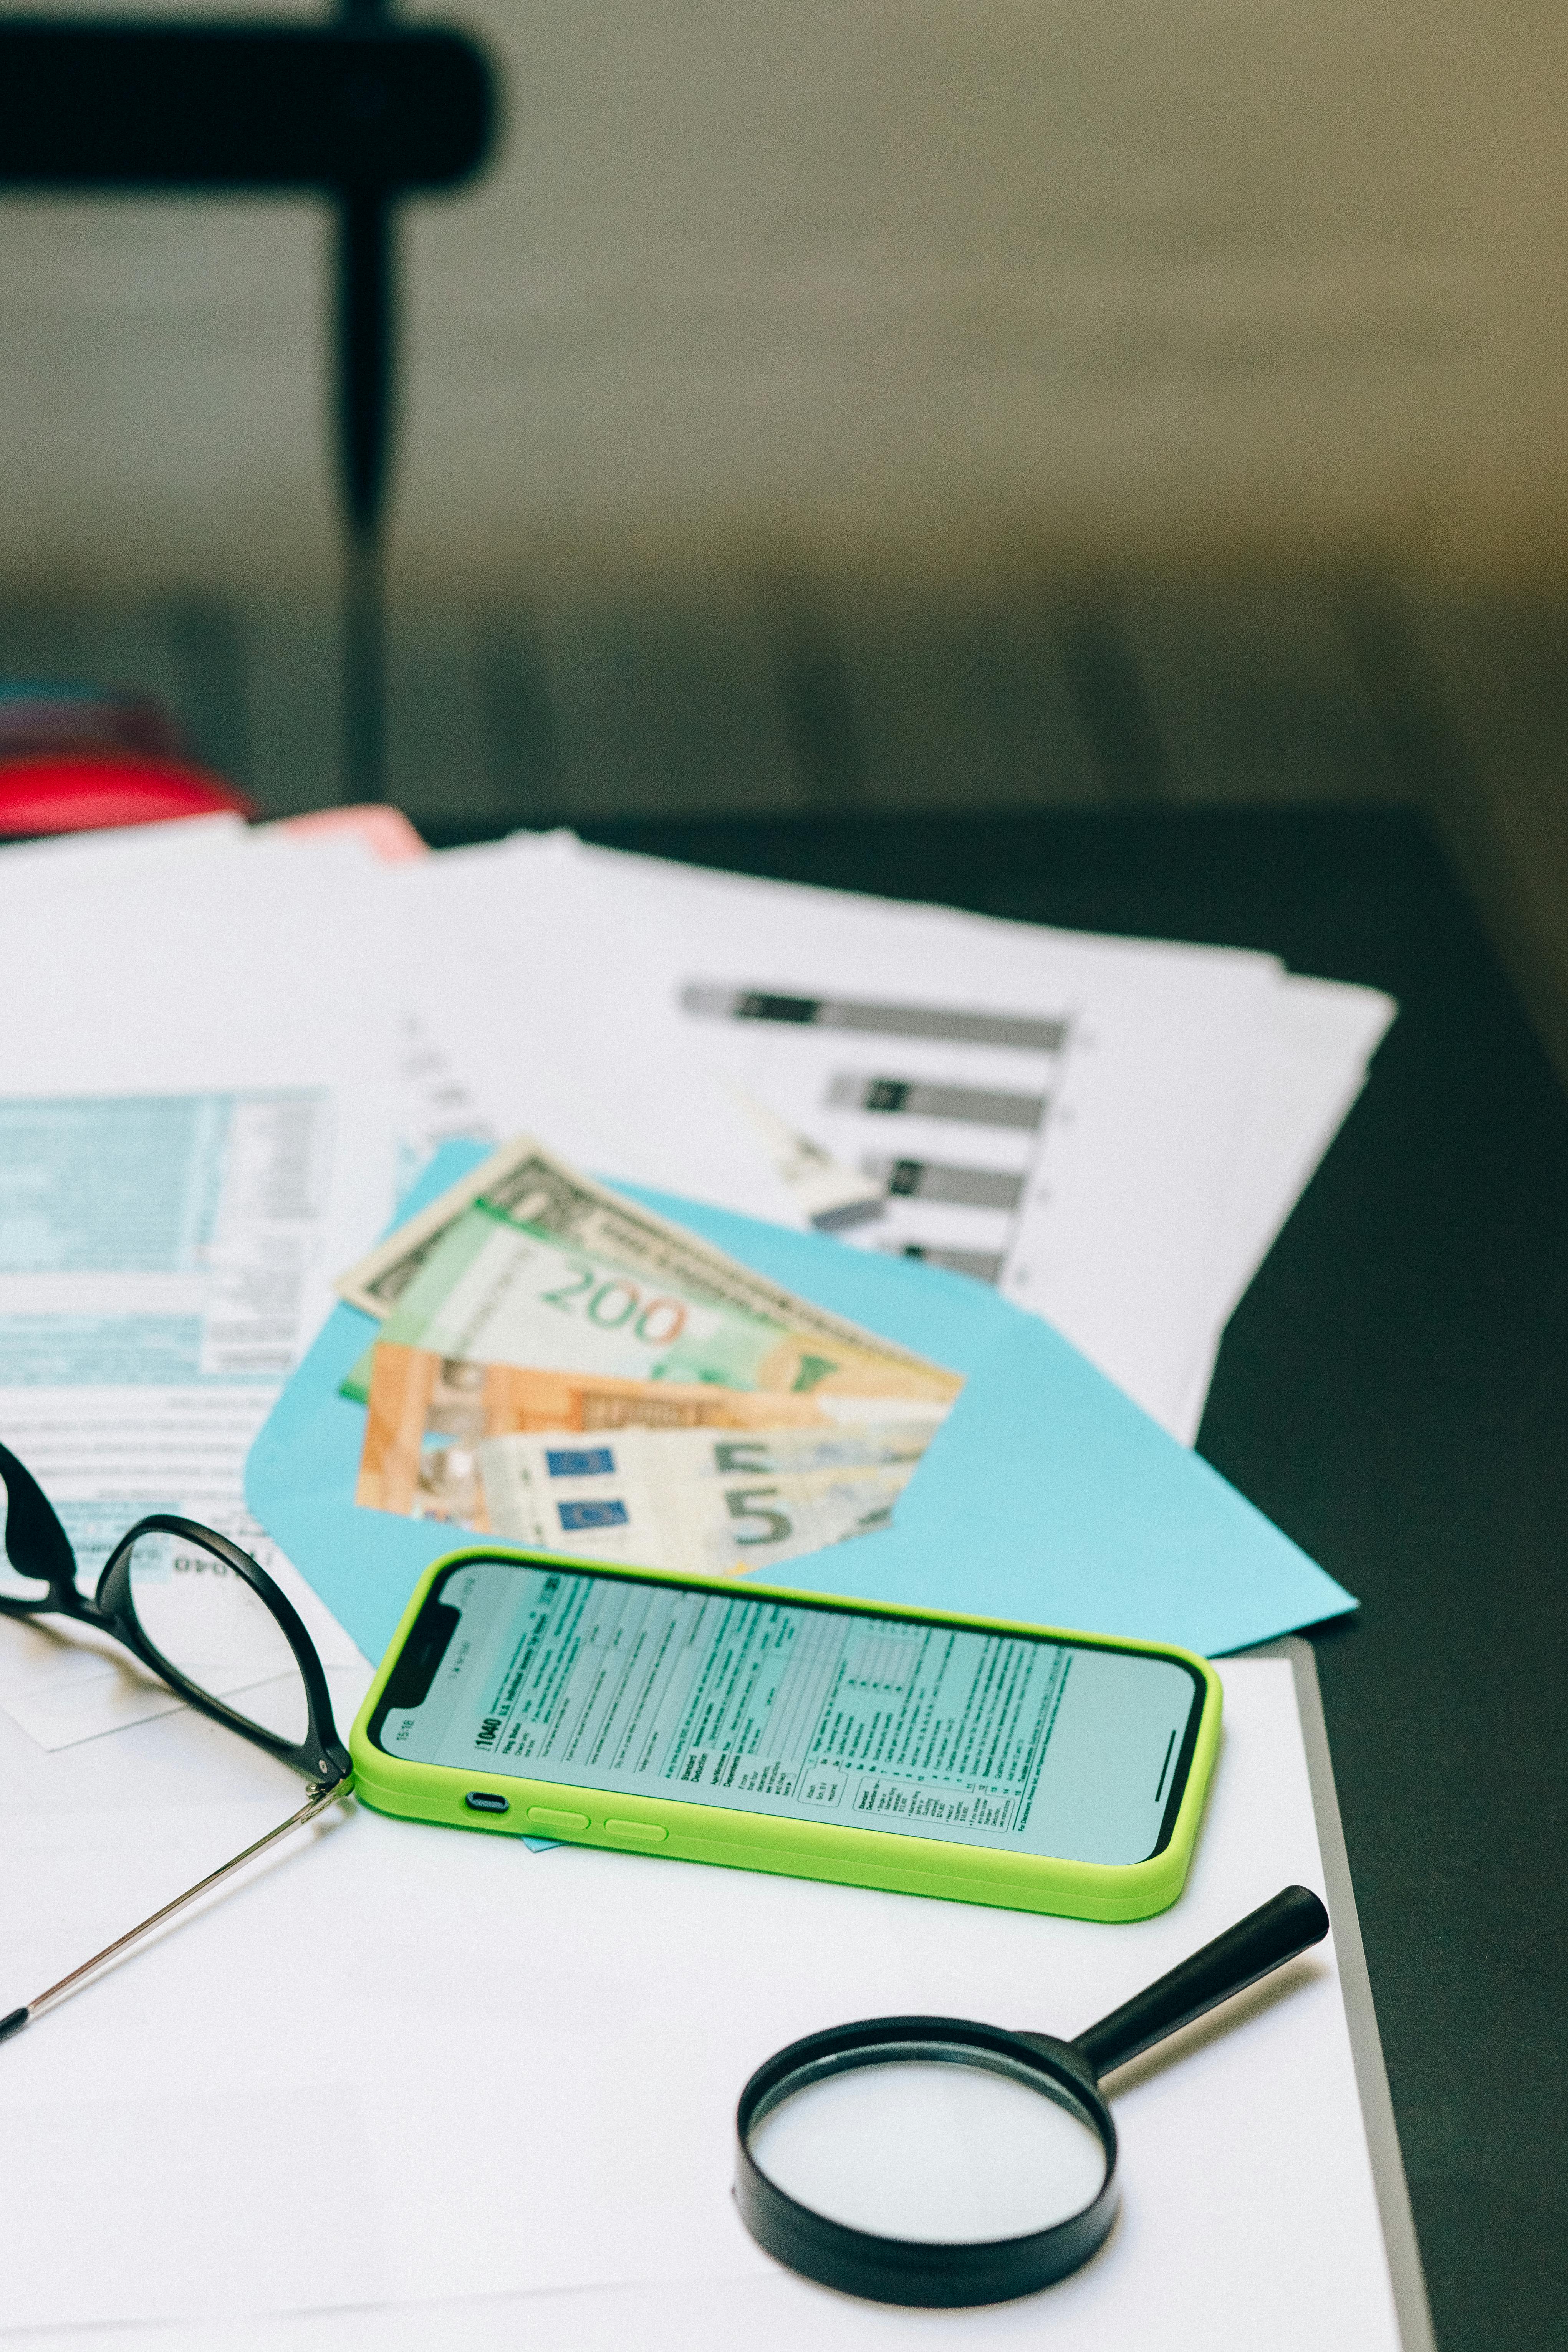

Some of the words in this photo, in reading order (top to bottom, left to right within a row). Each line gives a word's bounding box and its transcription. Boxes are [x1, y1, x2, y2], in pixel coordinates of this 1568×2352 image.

[538, 1254, 689, 1348] 200
[725, 1487, 793, 1546] 5
[474, 1717, 502, 1747] 1040
[681, 1754, 697, 1781] Standard
[690, 1753, 709, 1783] Deduction
[723, 1754, 742, 1788] Dependents
[858, 1790, 870, 1809] Standard
[866, 1789, 879, 1810] Deduction
